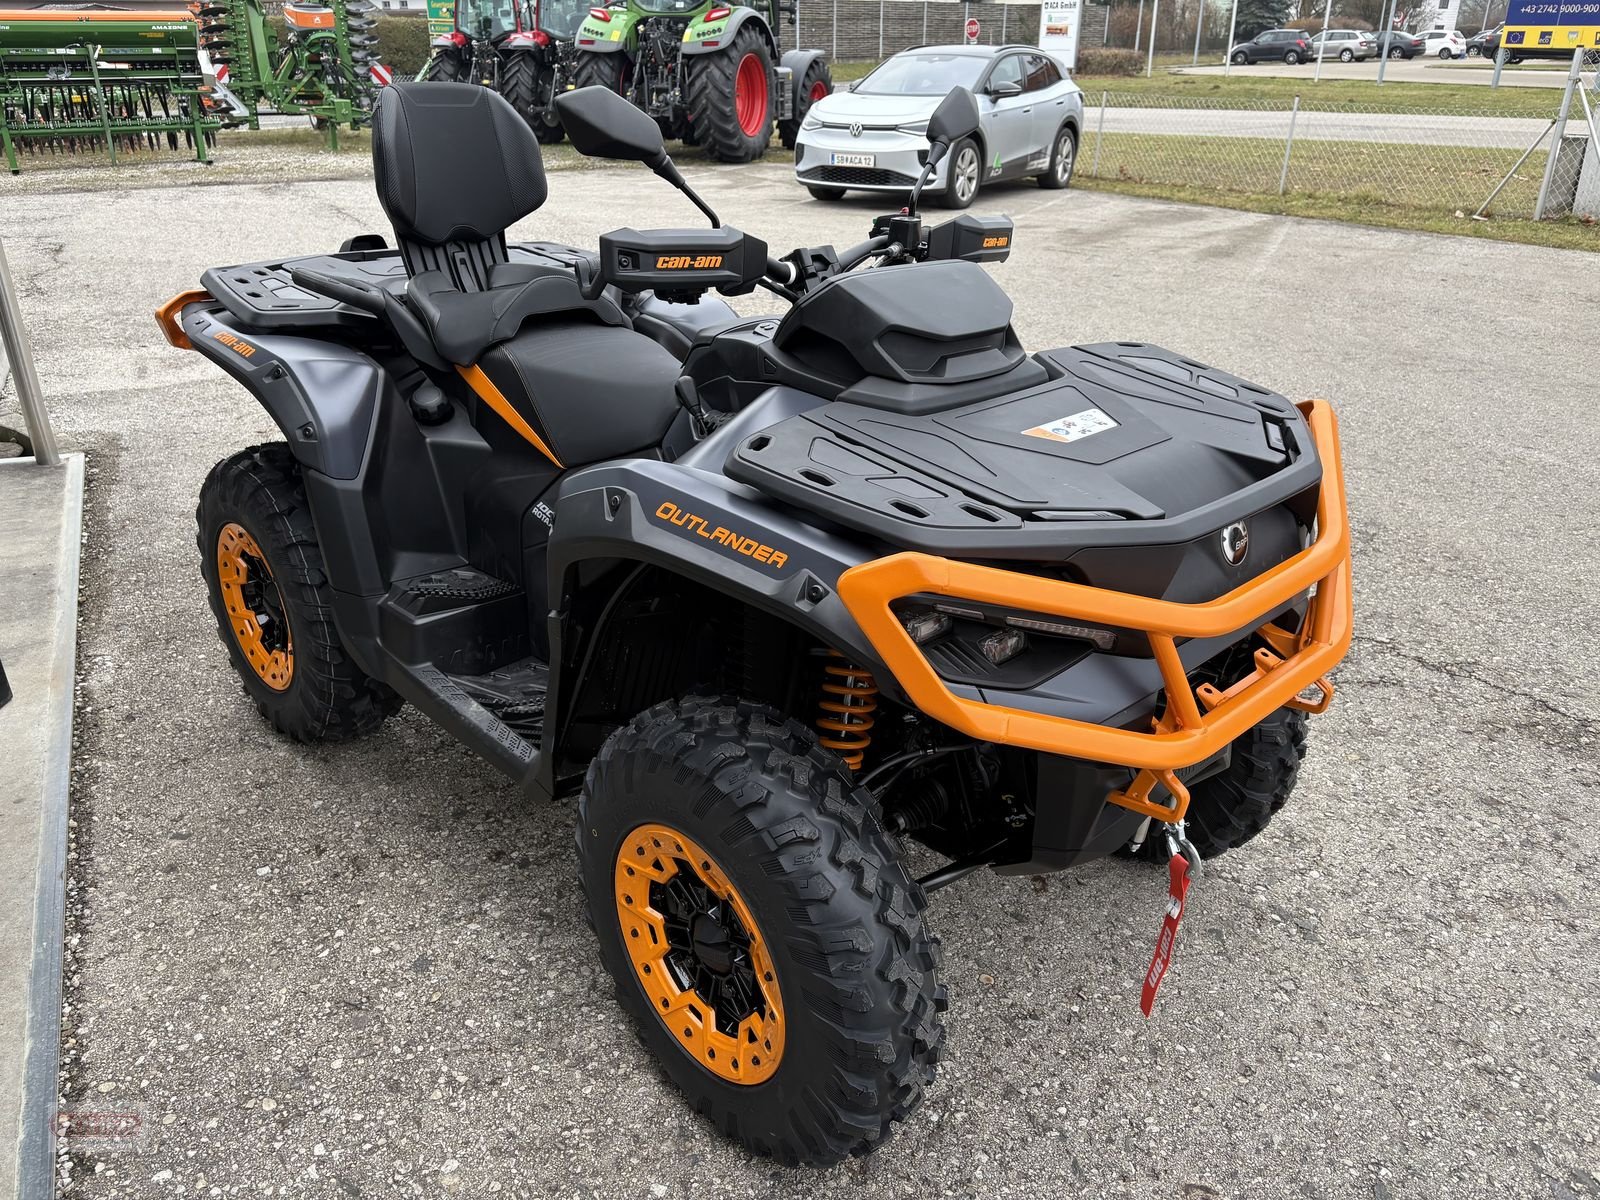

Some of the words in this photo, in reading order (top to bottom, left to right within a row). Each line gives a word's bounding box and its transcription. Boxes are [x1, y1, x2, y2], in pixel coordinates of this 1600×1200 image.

[1049, 1, 1059, 9] ACA
[1520, 4, 1537, 14] +43
[1537, 4, 1559, 14] 2742
[967, 25, 978, 33] STOP
[656, 255, 722, 269] can-am
[213, 331, 257, 358] can-am
[531, 506, 553, 527] ROTA
[655, 501, 789, 569] OUTLANDER
[1148, 925, 1173, 989] can-am
